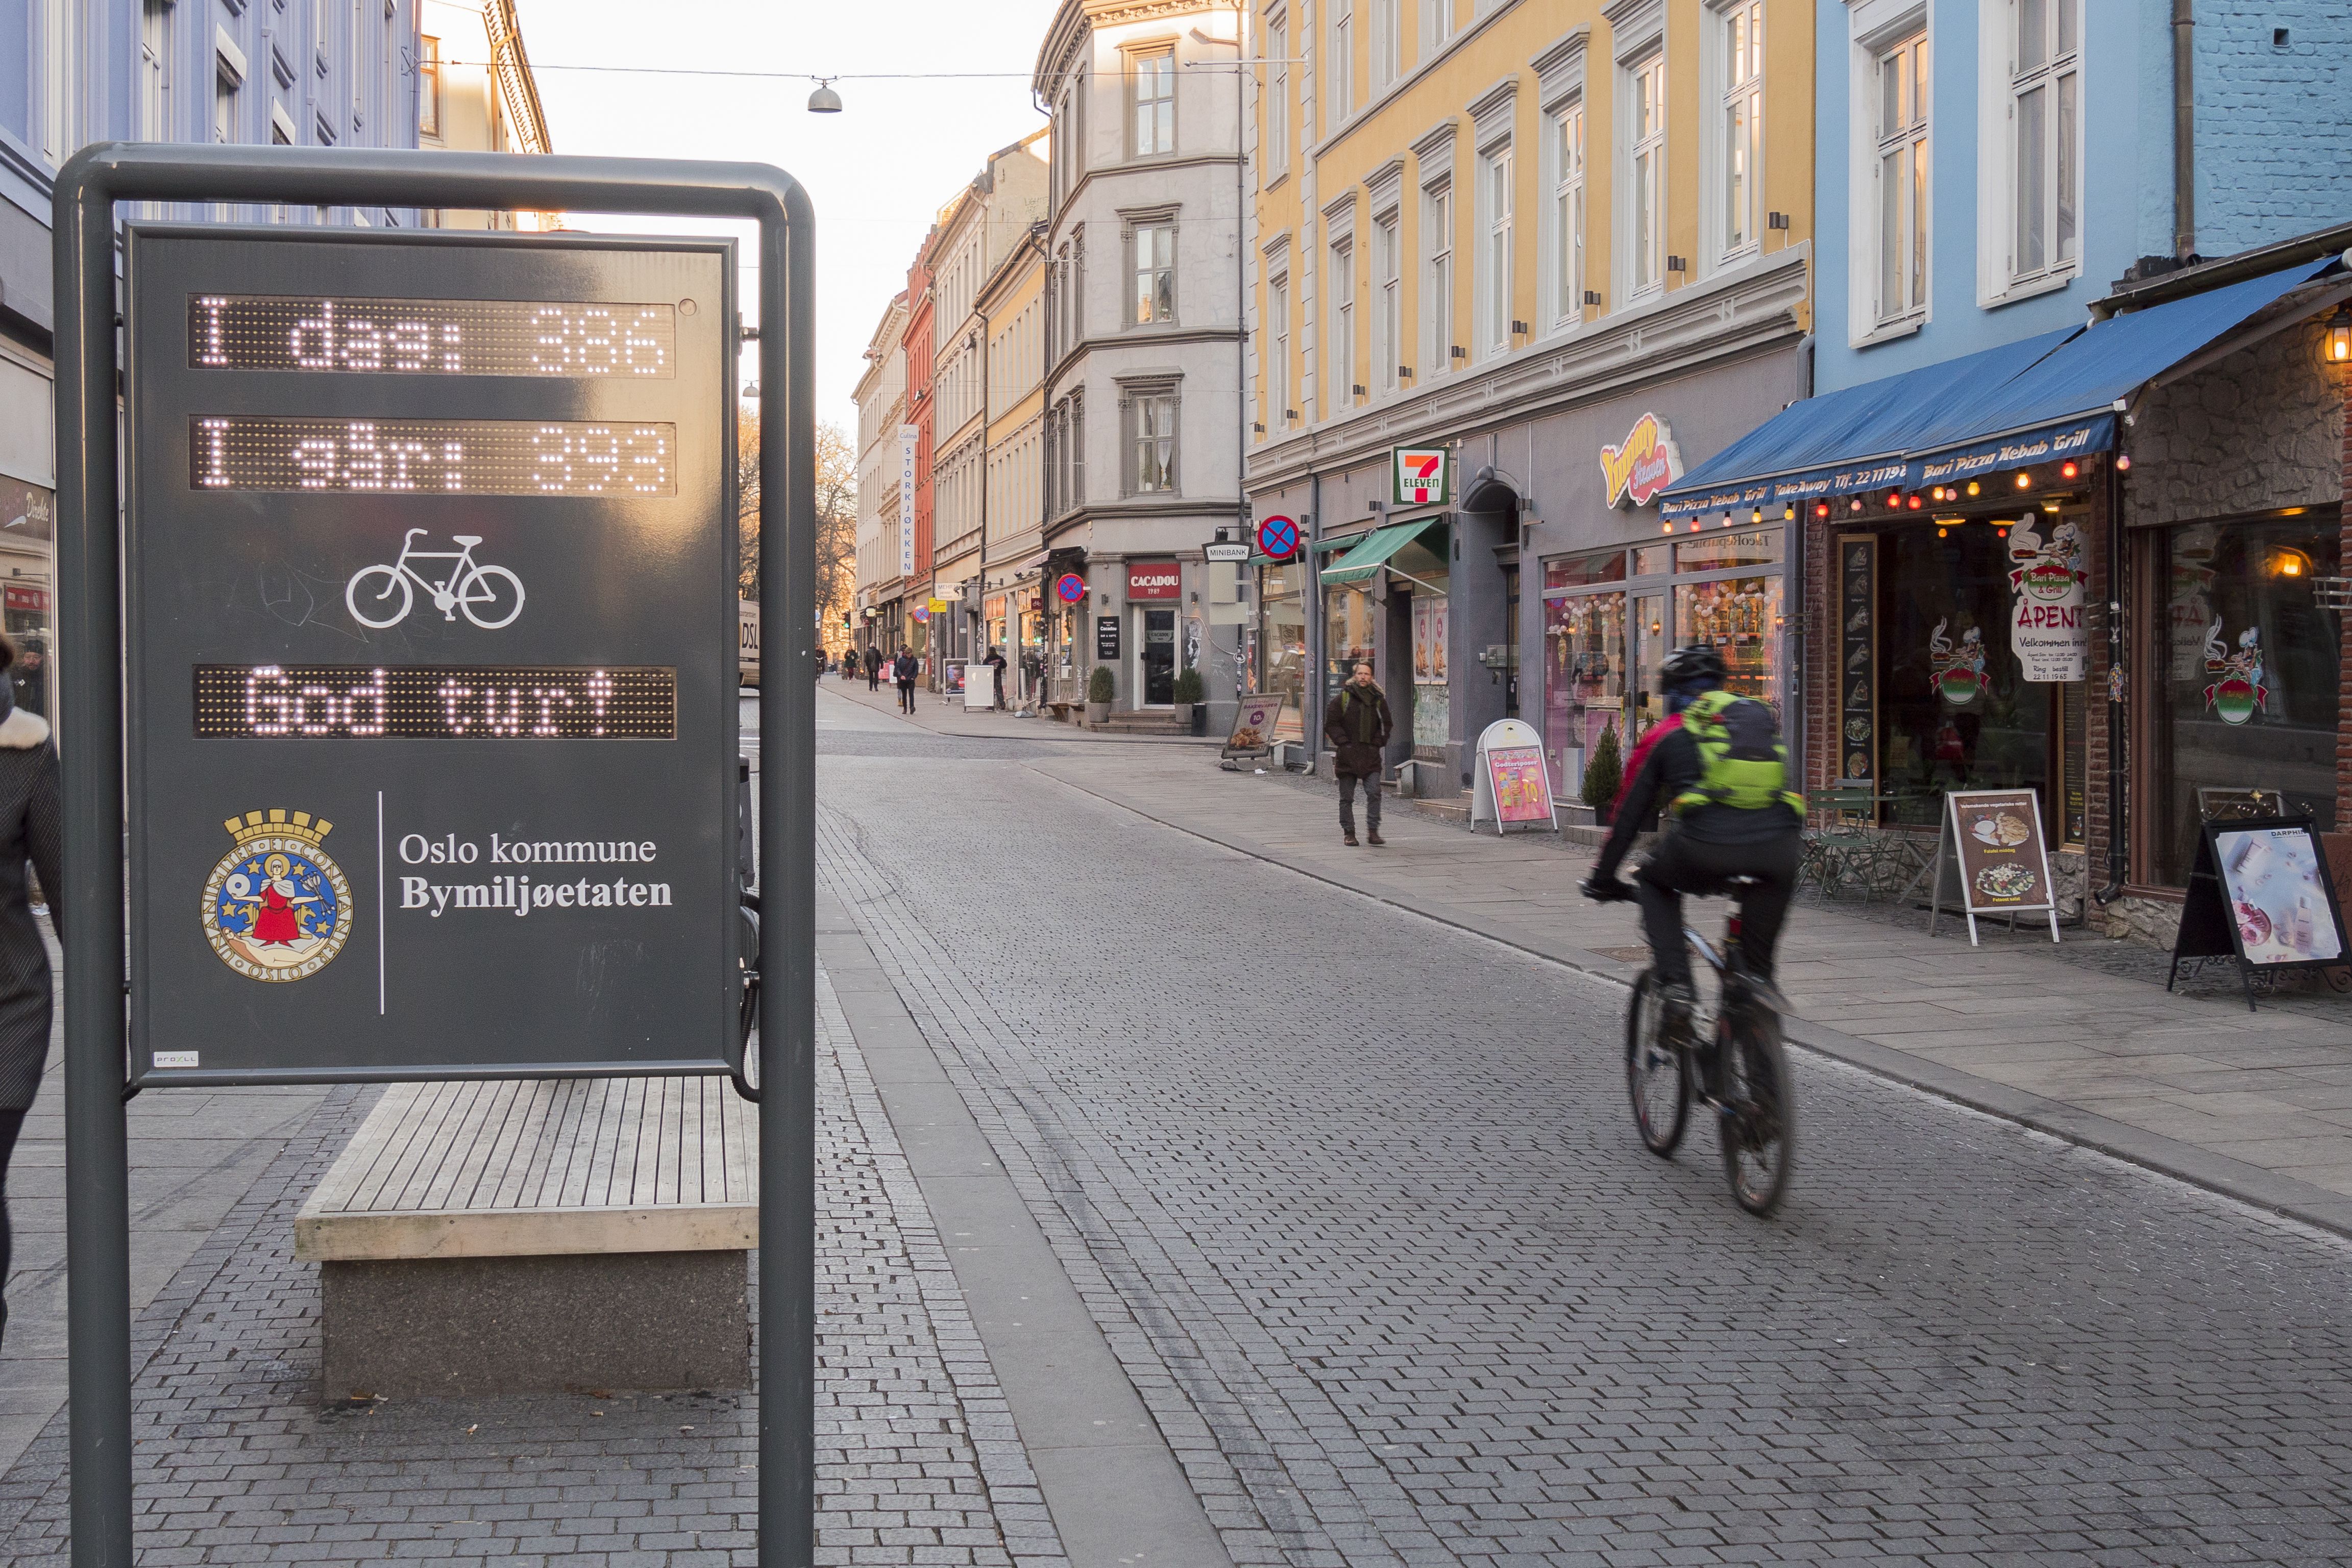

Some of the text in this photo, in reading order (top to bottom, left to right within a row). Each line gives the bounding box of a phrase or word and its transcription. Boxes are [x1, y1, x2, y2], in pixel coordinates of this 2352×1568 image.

[202, 299, 664, 374] I dag: 386
[203, 420, 665, 492] I går: 393
[1602, 419, 1657, 503] Yummy
[1922, 428, 2091, 479] Bari Pizza Kebab Grill
[1405, 455, 1439, 503] 7
[1633, 458, 1665, 489] Heaven
[1662, 501, 1682, 513] Bari
[1683, 498, 1709, 510] Pizza
[1710, 492, 1739, 507] Kebab
[1745, 486, 1767, 501] Grill
[1131, 576, 1179, 586] CACADOU
[2030, 572, 2070, 582] Bari Pizza
[2017, 598, 2082, 628] ÅPENT
[742, 622, 758, 649] DSL
[2019, 637, 2070, 647] Velkommen
[247, 667, 612, 734] God tur!
[399, 833, 656, 864] Oslo kommune
[399, 875, 673, 918] Bymiljøetaten
[249, 966, 302, 981] OSLO
